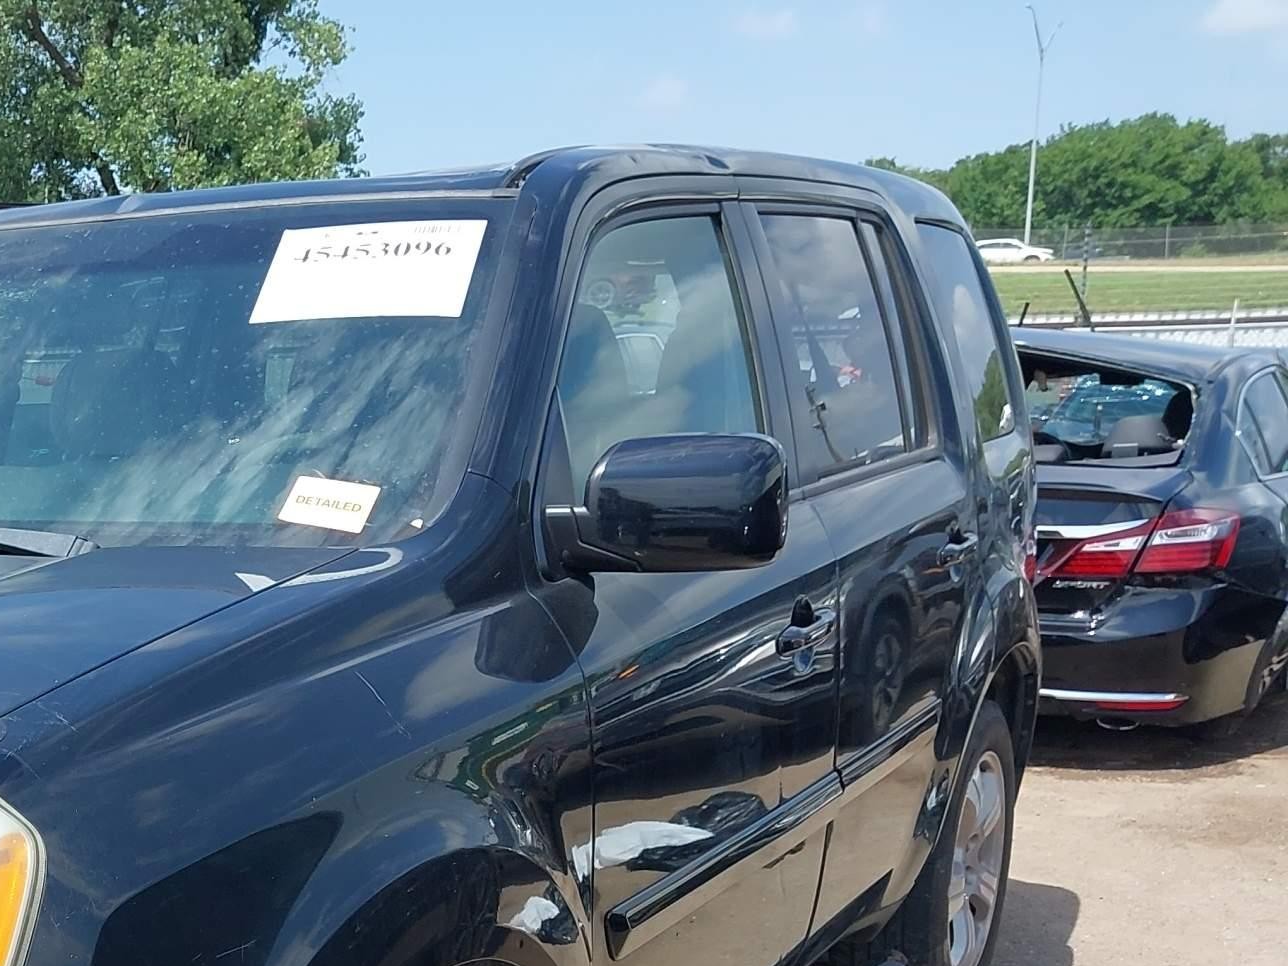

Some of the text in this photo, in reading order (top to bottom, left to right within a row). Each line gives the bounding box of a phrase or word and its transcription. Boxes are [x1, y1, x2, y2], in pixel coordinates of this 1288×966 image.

[293, 240, 452, 263] 45453096
[295, 494, 362, 513] DETAILED
[1051, 579, 1111, 590] SPORT
